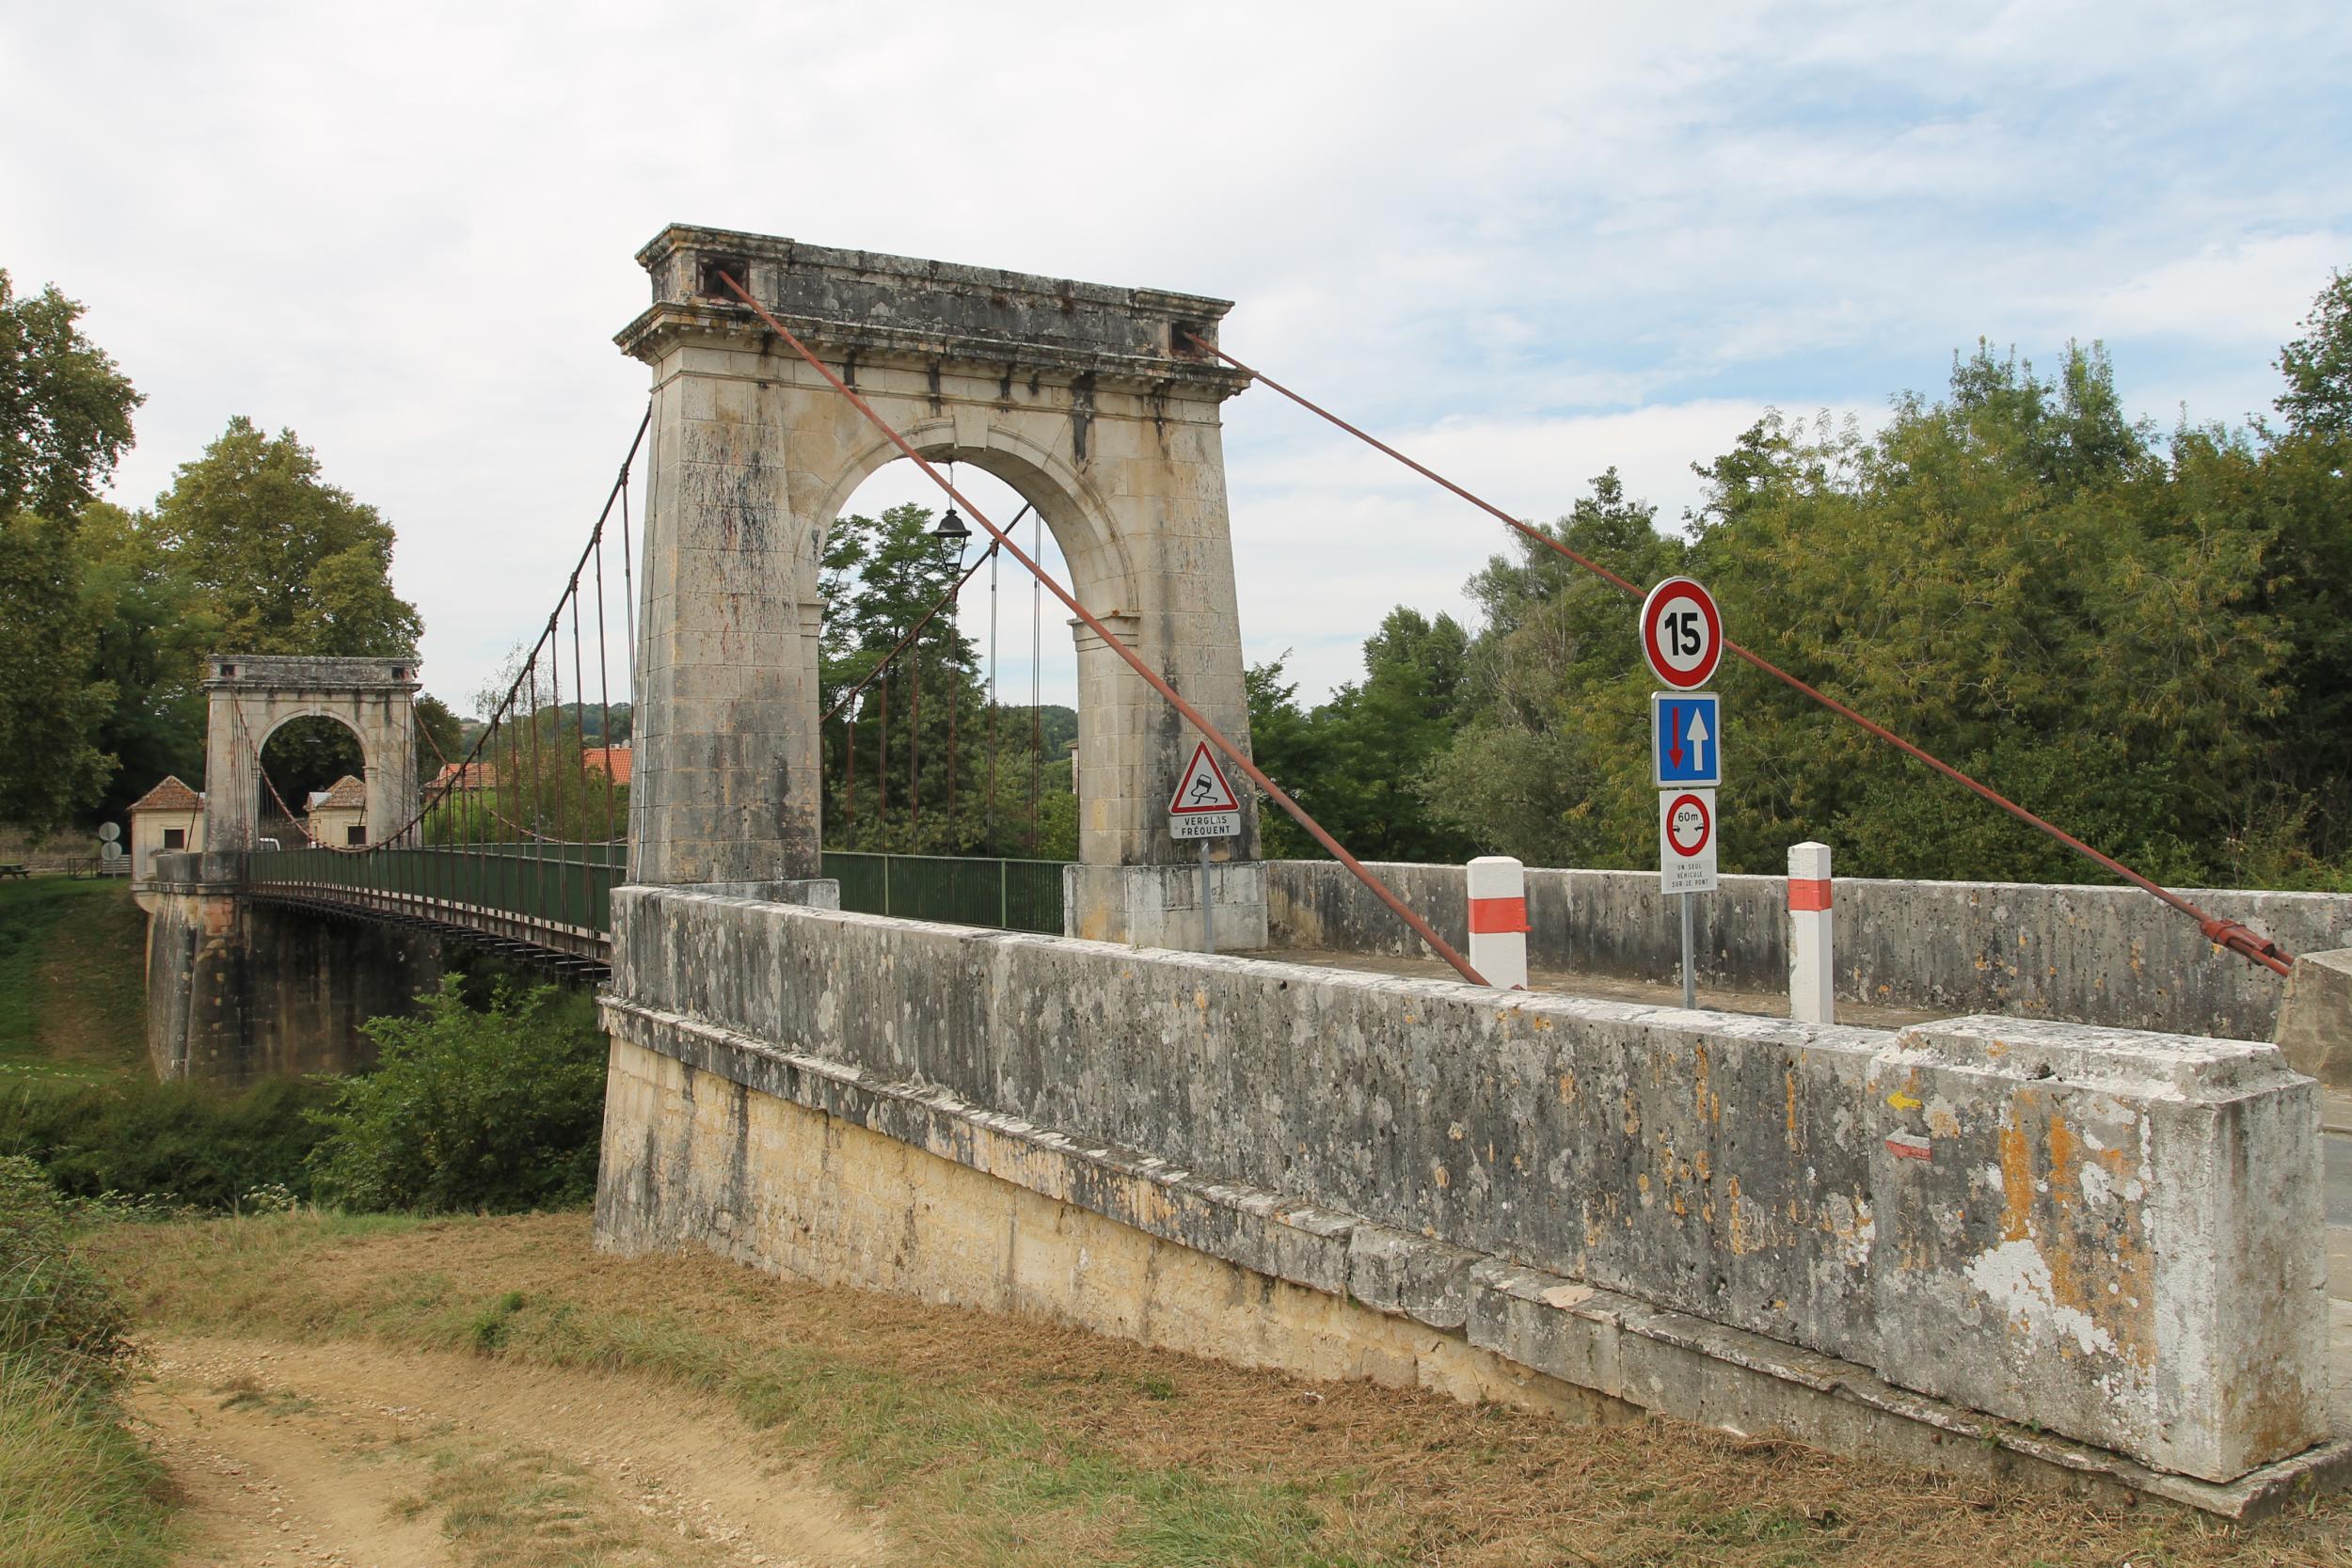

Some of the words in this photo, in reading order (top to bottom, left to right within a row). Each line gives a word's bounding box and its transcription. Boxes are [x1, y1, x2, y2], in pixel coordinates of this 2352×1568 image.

[1664, 612, 1701, 657] 15
[1184, 816, 1228, 826] VERGLAS
[1678, 812, 1698, 822] 60m
[1182, 826, 1231, 835] FRÉQUENT
